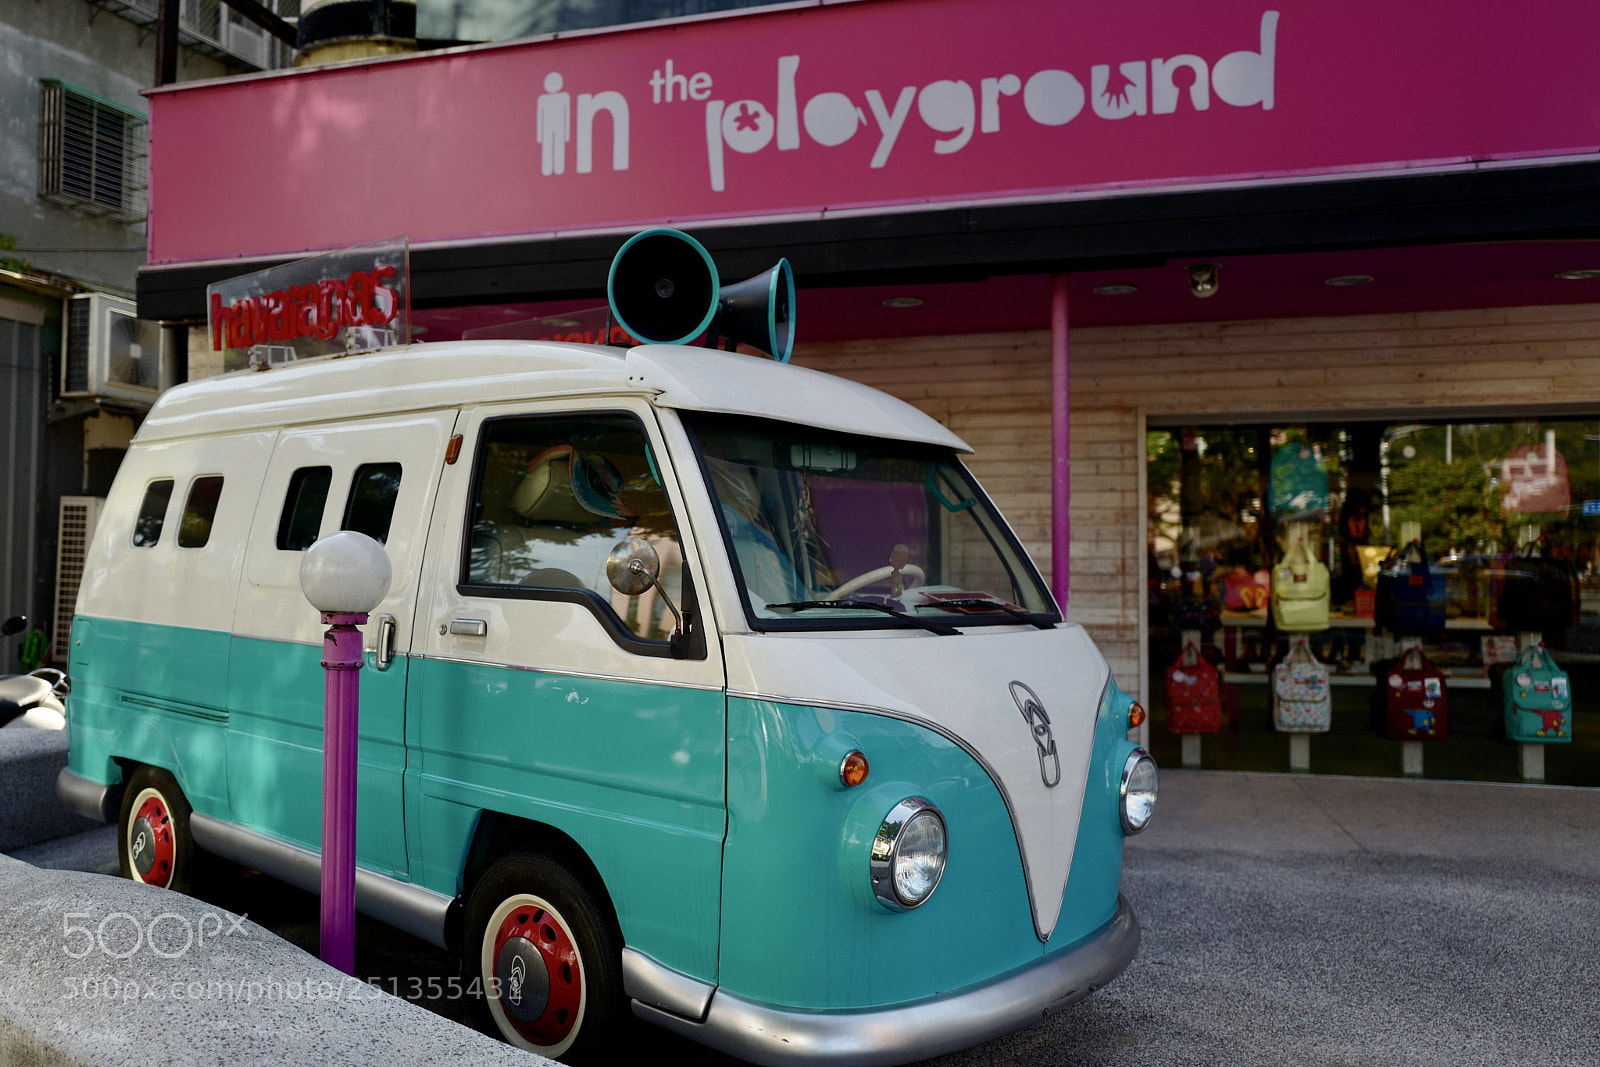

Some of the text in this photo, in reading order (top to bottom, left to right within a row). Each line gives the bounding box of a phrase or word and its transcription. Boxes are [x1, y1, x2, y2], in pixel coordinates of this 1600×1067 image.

[536, 71, 630, 177] in
[648, 59, 713, 104] the
[211, 264, 399, 351] havaianas
